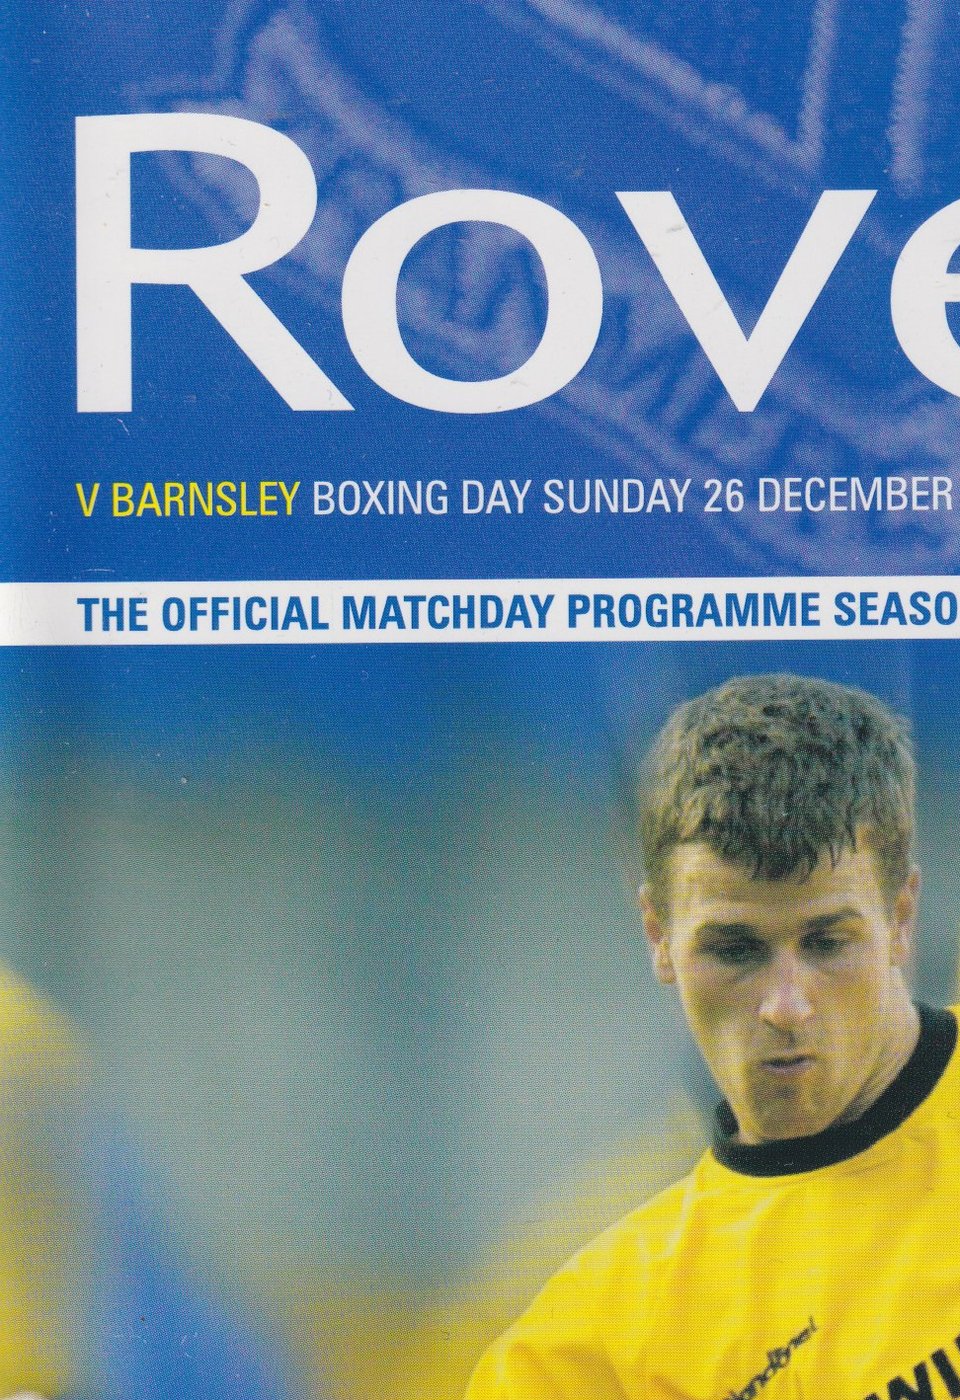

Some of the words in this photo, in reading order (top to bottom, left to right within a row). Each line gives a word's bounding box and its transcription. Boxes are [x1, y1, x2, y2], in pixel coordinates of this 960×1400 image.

[76, 482, 100, 516] V
[113, 481, 301, 517] BARNSLEY
[313, 480, 449, 515] BOXING
[462, 479, 534, 514] DAY
[543, 478, 688, 514] SUNDAY
[704, 478, 744, 513] 26
[759, 477, 952, 512] DECEMBER
[77, 598, 149, 632] THE
[161, 597, 327, 632] OFFICIAL
[343, 595, 555, 630] MATCHDAY
[568, 593, 820, 629] PROGRAMME
